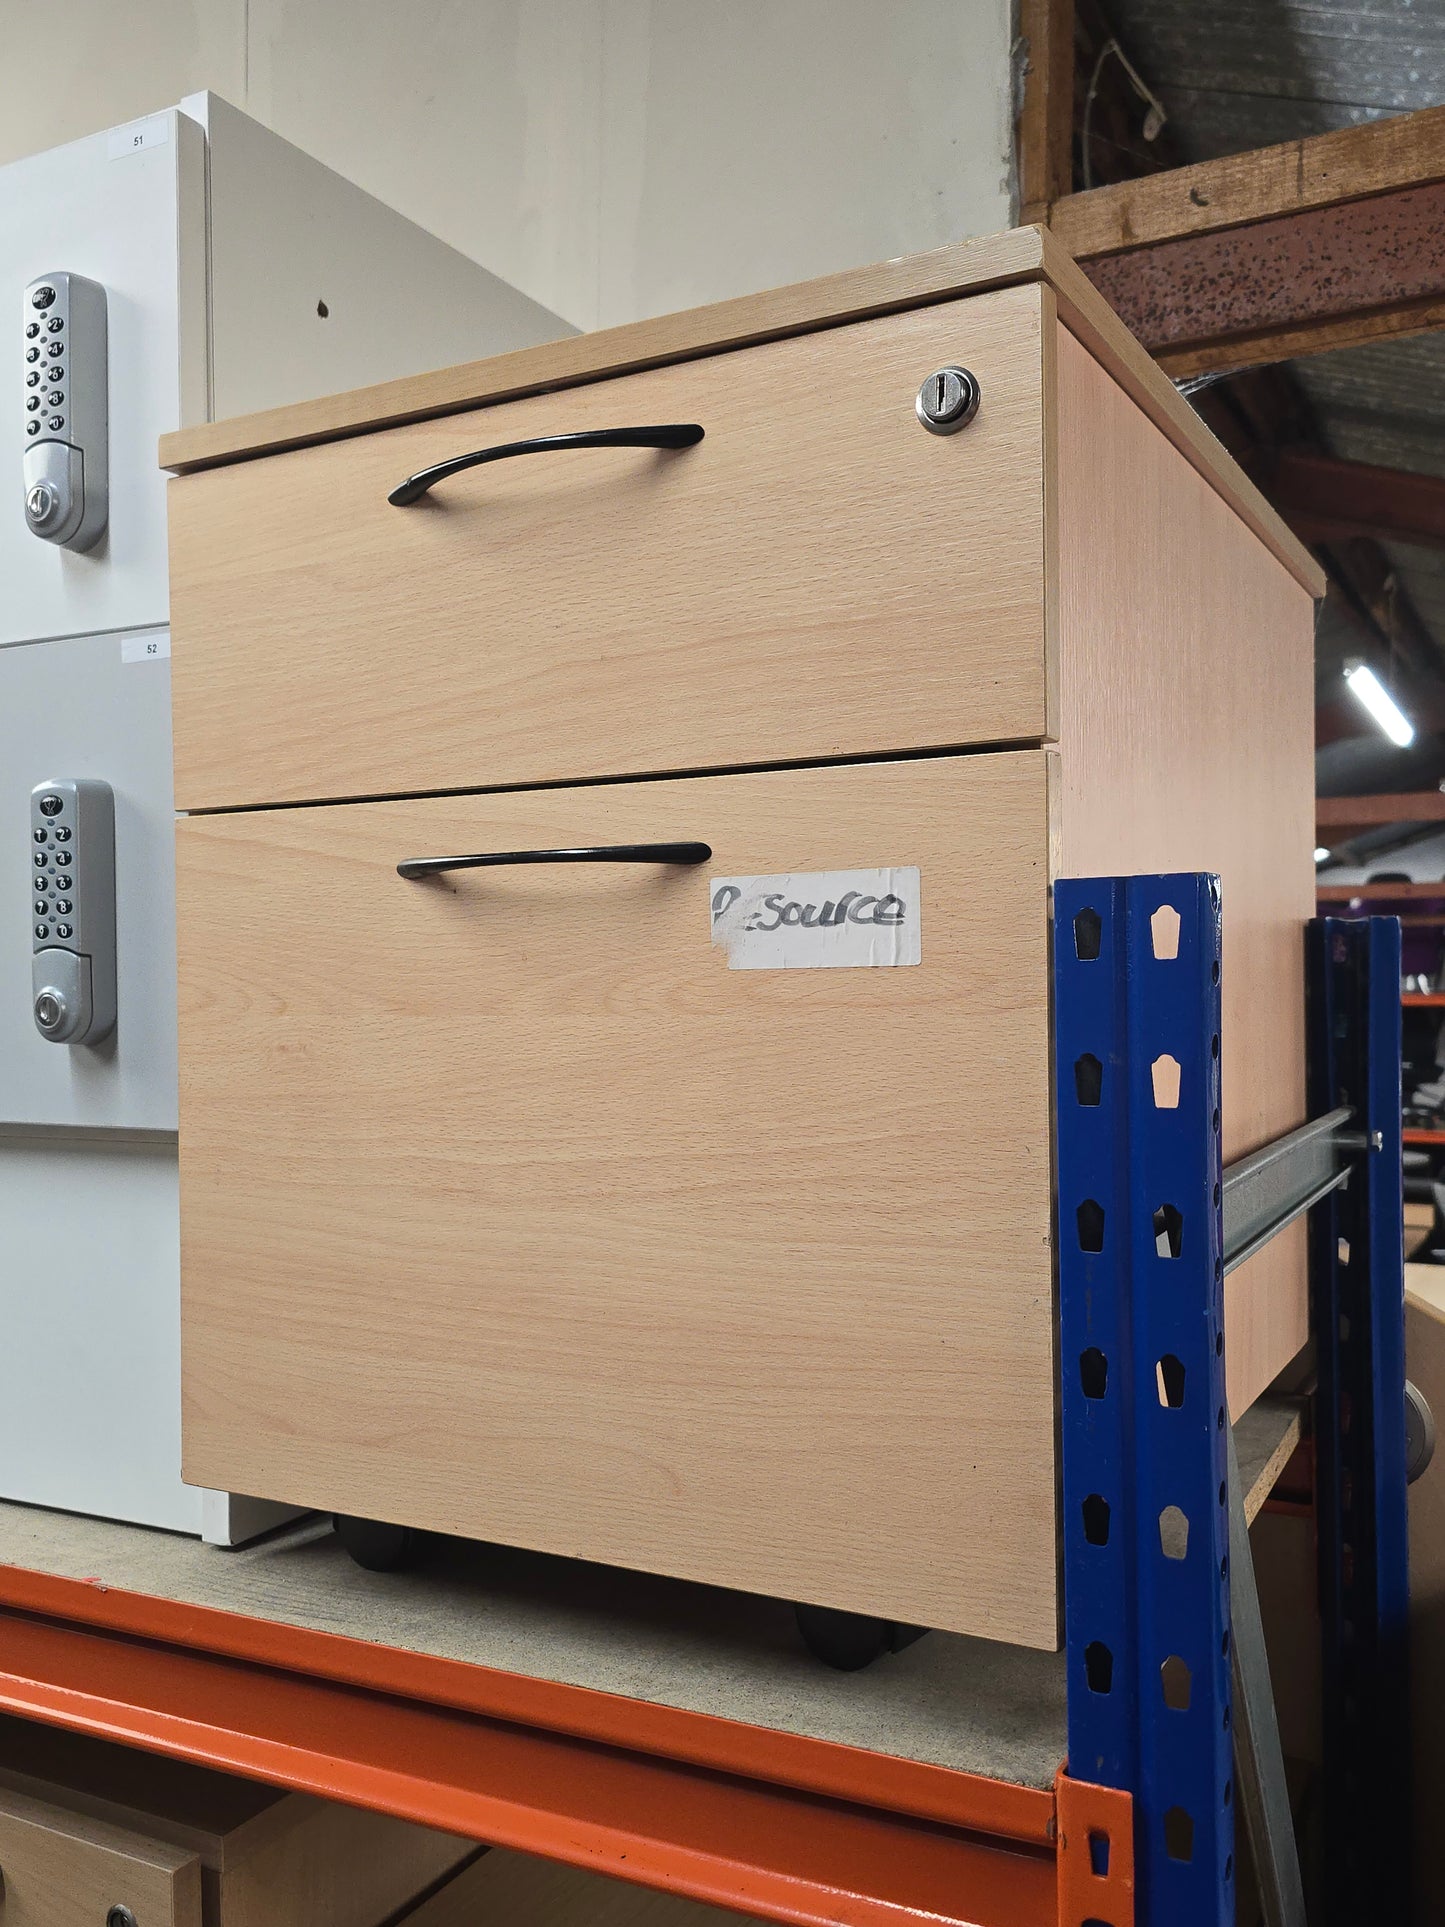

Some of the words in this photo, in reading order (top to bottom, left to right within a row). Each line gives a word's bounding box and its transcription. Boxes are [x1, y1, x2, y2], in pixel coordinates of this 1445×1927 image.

[134, 135, 143, 146] 51
[52, 319, 59, 330] 2
[52, 344, 58, 354] 4
[52, 368, 58, 379] 6
[53, 392, 59, 404] 8
[53, 417, 59, 429] 0
[147, 644, 157, 654] 52
[59, 829, 65, 840] 2
[60, 901, 67, 913] 8
[38, 925, 44, 938] 9
[60, 925, 68, 937] 0
